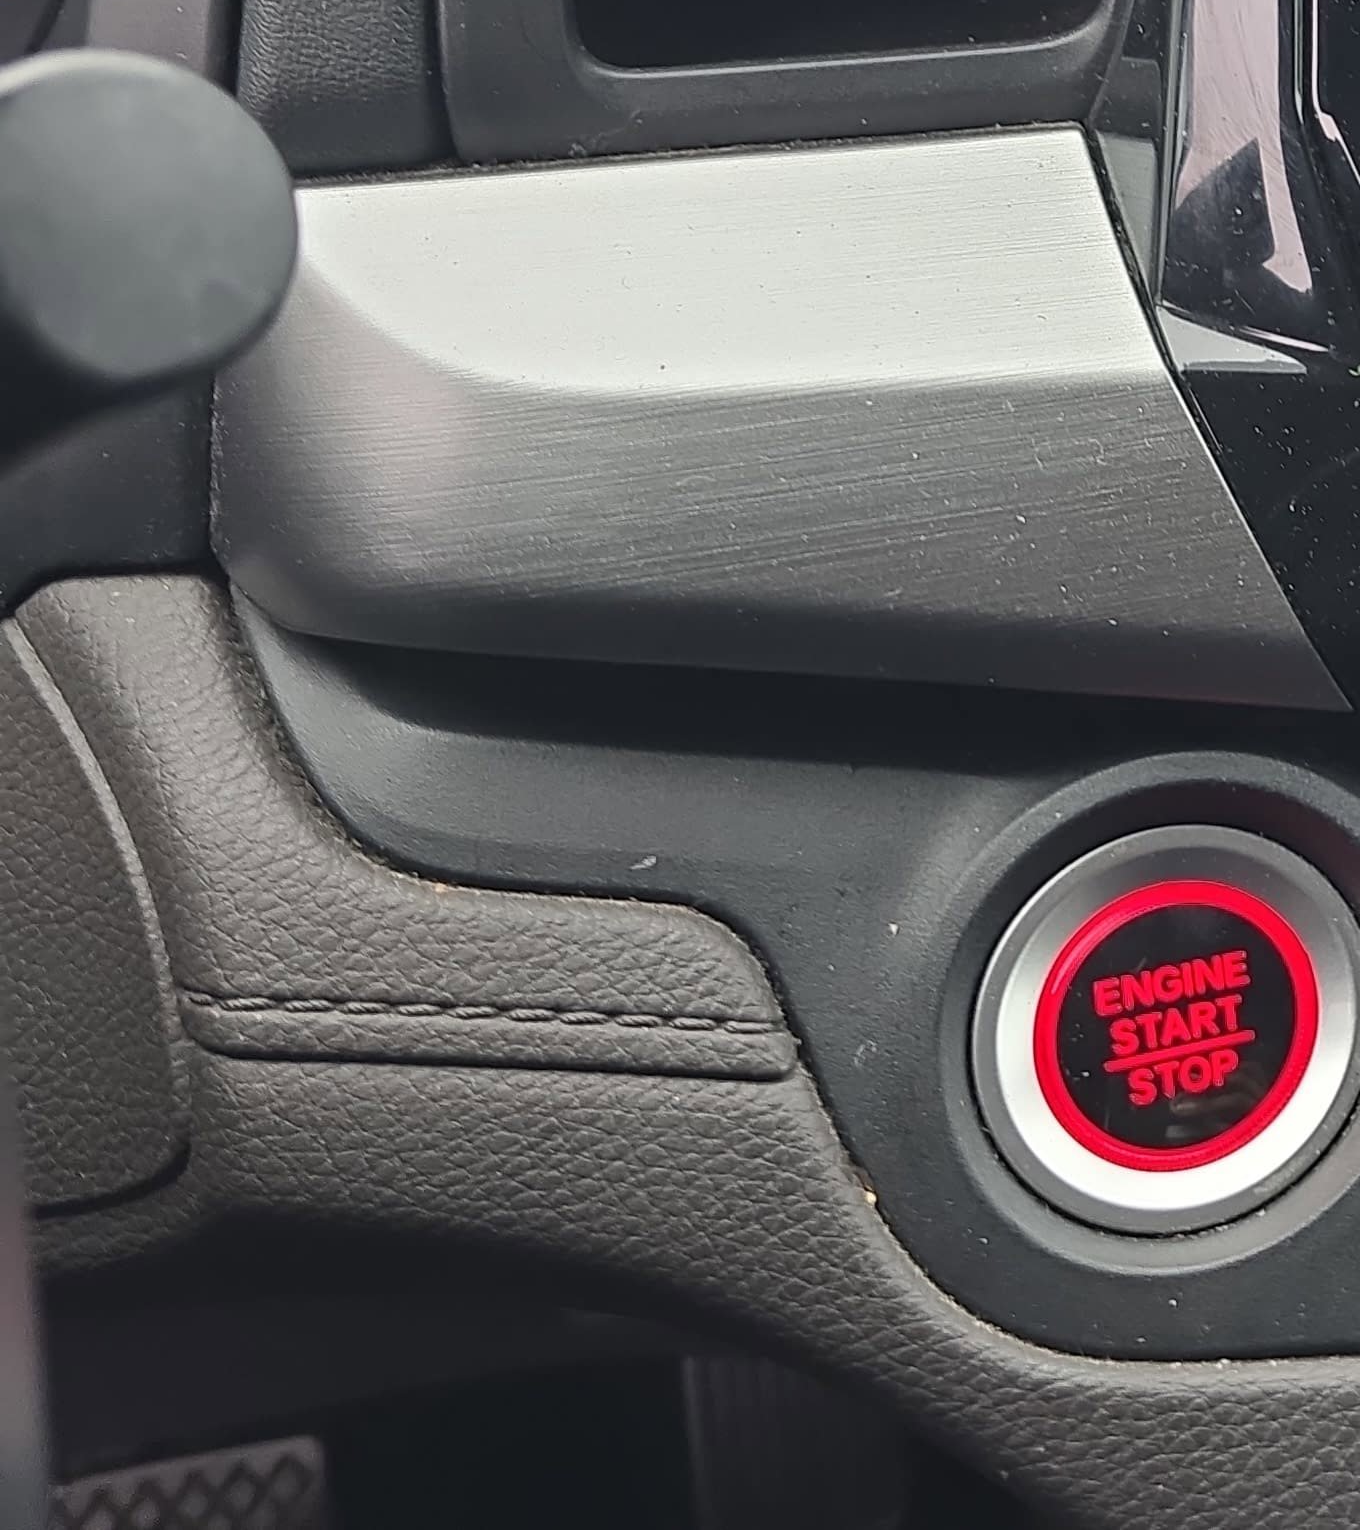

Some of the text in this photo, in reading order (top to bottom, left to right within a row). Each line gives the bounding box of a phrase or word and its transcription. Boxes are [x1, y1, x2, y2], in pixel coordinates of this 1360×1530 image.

[1092, 949, 1251, 1017] ENGINE
[1109, 993, 1243, 1057] START
[1128, 1048, 1239, 1107] STOP
